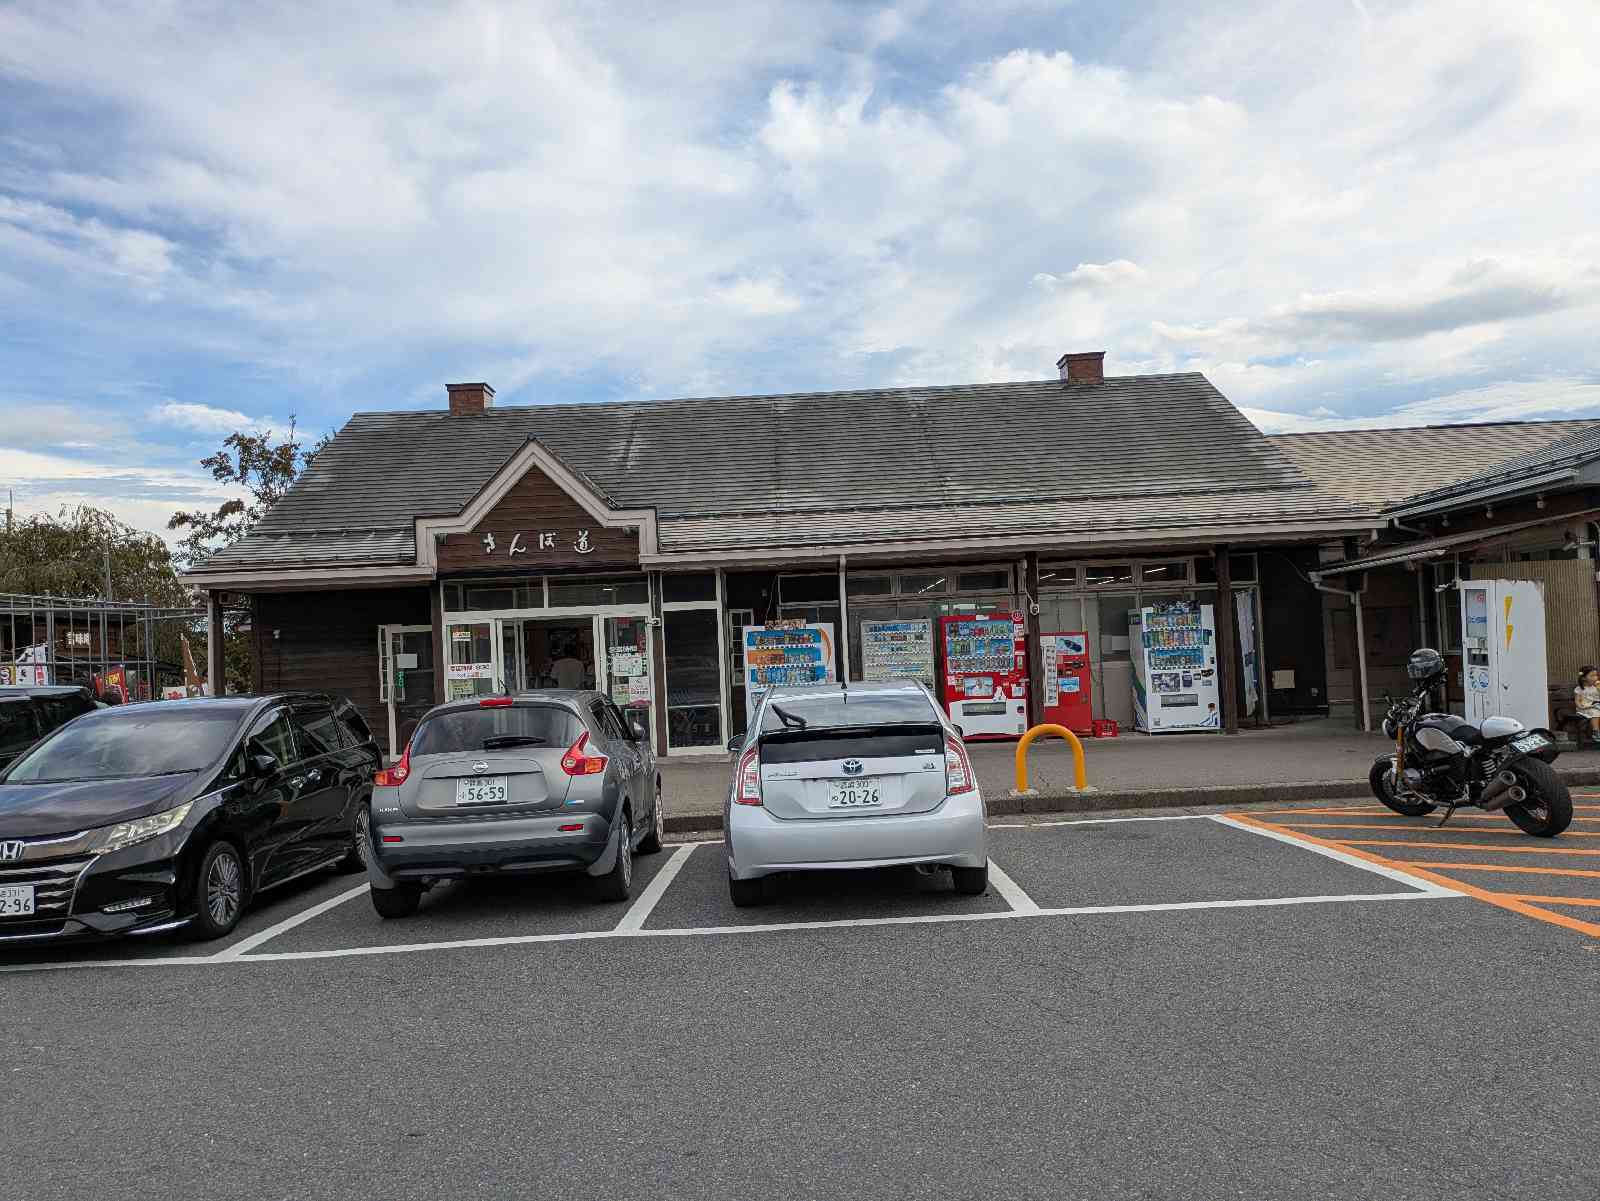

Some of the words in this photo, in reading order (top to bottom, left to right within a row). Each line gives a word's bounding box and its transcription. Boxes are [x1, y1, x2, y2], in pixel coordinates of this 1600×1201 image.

[483, 530, 595, 556] さんぽ道
[468, 787, 505, 801] 56-59
[840, 789, 879, 804] 20-26
